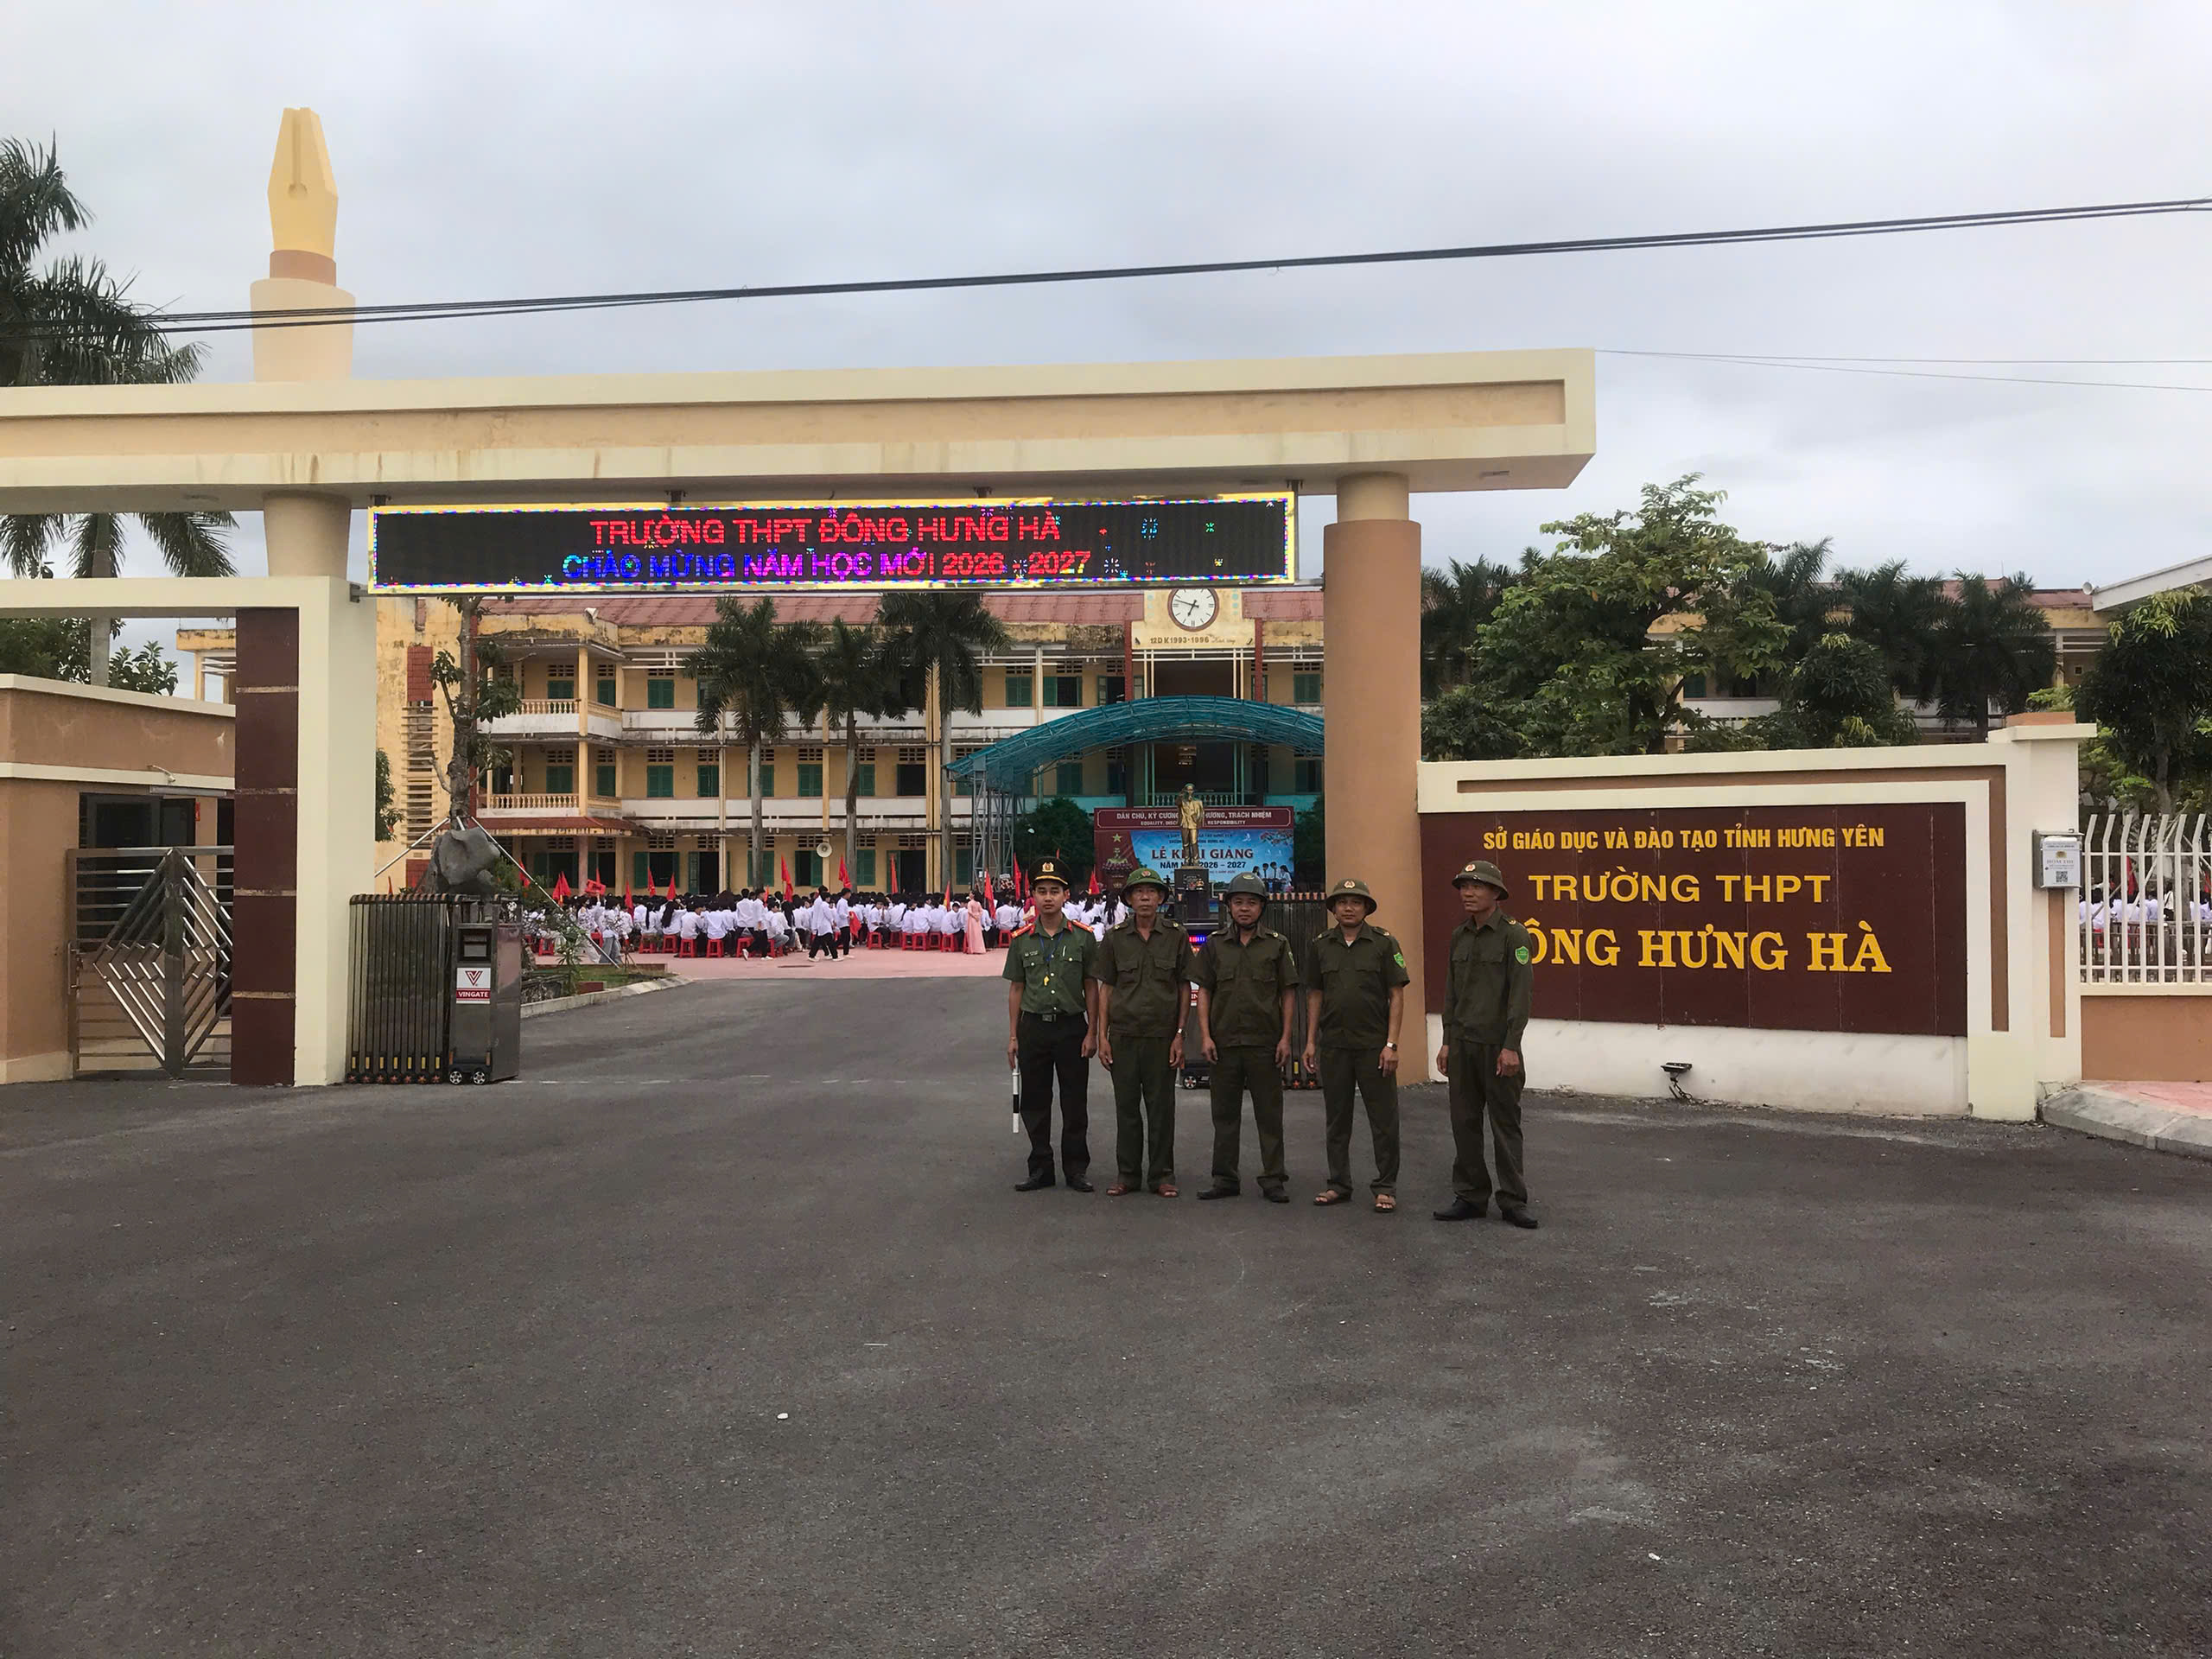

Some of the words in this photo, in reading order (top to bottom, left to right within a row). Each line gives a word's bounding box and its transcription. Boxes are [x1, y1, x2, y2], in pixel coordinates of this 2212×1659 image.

[589, 514, 725, 545] TRƯỜNG
[732, 518, 812, 543] THPT
[818, 512, 908, 543] ĐÔNG
[918, 516, 1009, 542] HƯNG
[1018, 511, 1061, 541] HÀ
[563, 549, 642, 578] CHÀO
[650, 549, 735, 578] MỪNG
[744, 548, 804, 577] NĂM
[811, 552, 873, 581] HỌC
[880, 546, 935, 576] MỚI
[942, 551, 1005, 575] 2026
[1027, 550, 1091, 575] 2027
[1483, 825, 1508, 850] SỞ
[1512, 828, 1555, 850] GIÁO
[1560, 830, 1599, 854] DỤC
[1604, 827, 1630, 849] VÀ
[1634, 826, 1674, 849] ĐÀO
[1680, 830, 1718, 853] TẠO
[1724, 823, 1770, 849] TỈNH
[1777, 826, 1835, 848] HƯNG
[1841, 823, 1885, 848] YÊN
[1528, 866, 1700, 903] TRƯỜNG
[1715, 874, 1831, 904] THPT
[1523, 917, 1621, 967] ÔNG
[1637, 923, 1789, 971] HƯNG
[1806, 919, 1892, 973] HÀ
